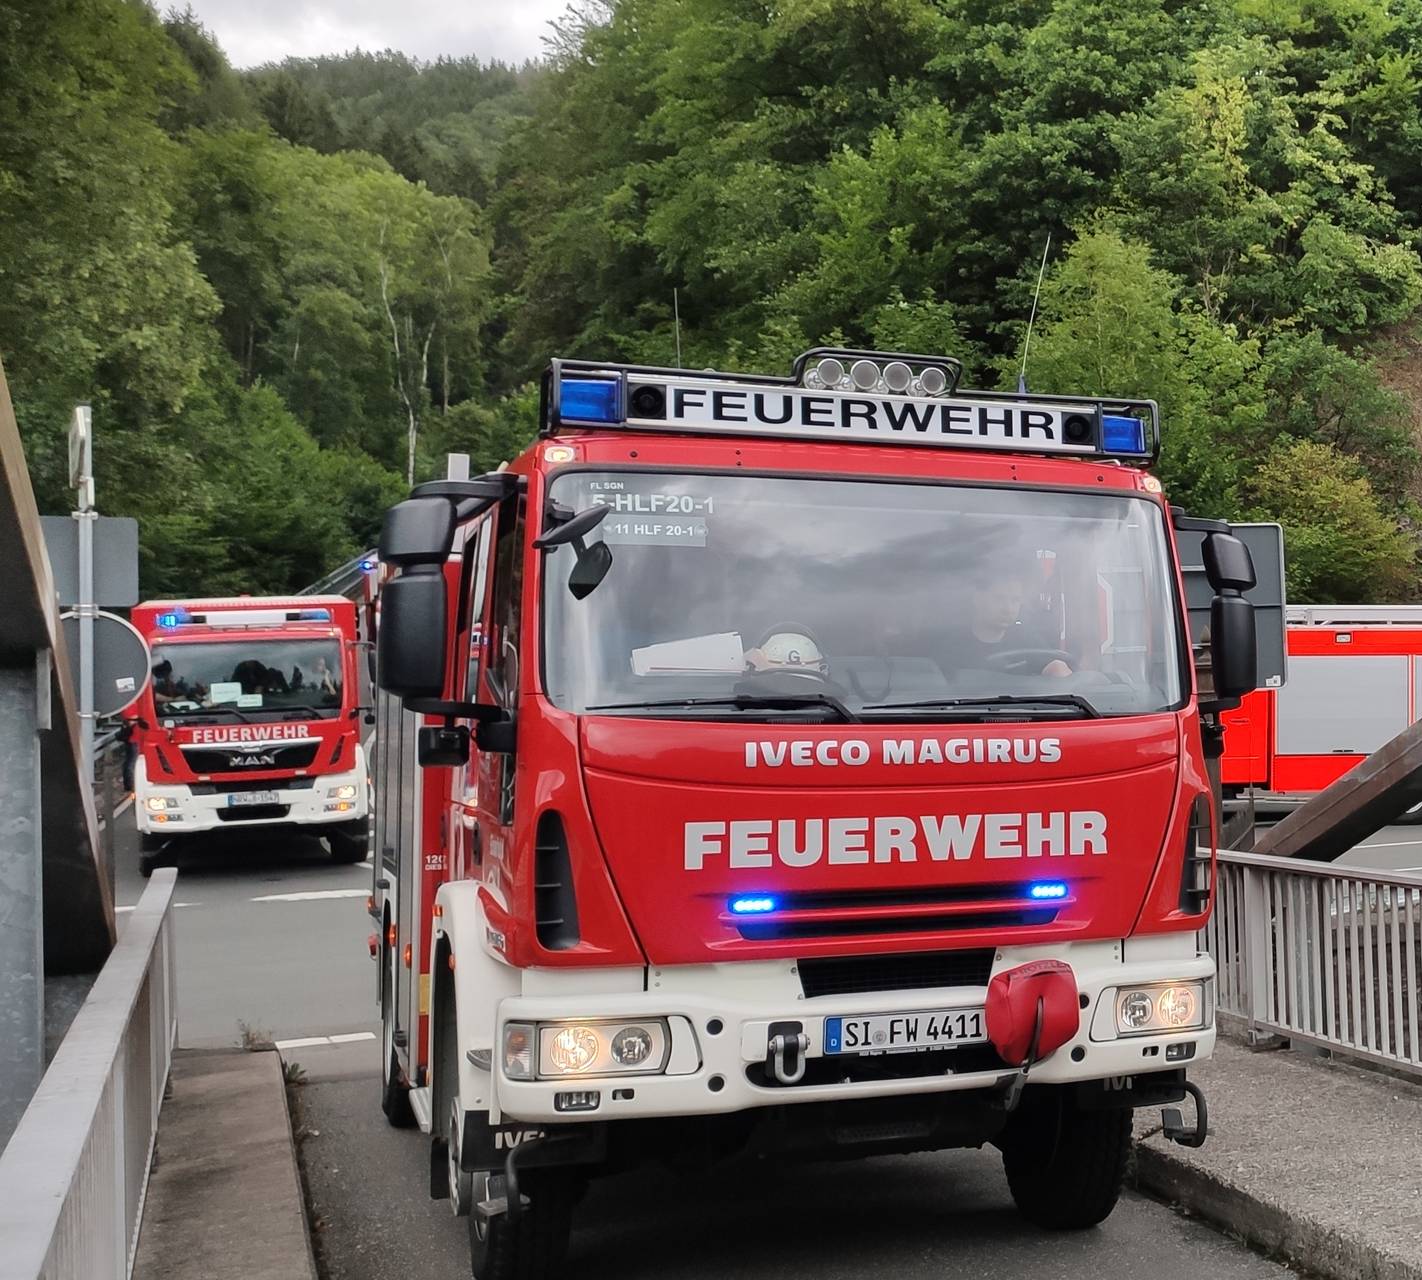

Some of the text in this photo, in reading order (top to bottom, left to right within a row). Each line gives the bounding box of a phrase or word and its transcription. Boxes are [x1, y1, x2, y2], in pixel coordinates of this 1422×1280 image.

[674, 388, 1054, 440] FEUERWEHR
[590, 482, 624, 490] FL SGN
[592, 493, 714, 514] 5-HLF20-1
[615, 524, 694, 537] 11 HLF 20-1
[192, 724, 309, 743] FEUERWEHR
[229, 755, 275, 767] MAN
[745, 738, 1062, 768] IVECO MAGIRUS
[684, 810, 1108, 870] FEUERWEHR
[845, 1013, 982, 1047] SI FW 4411
[495, 1130, 545, 1150] IVE
